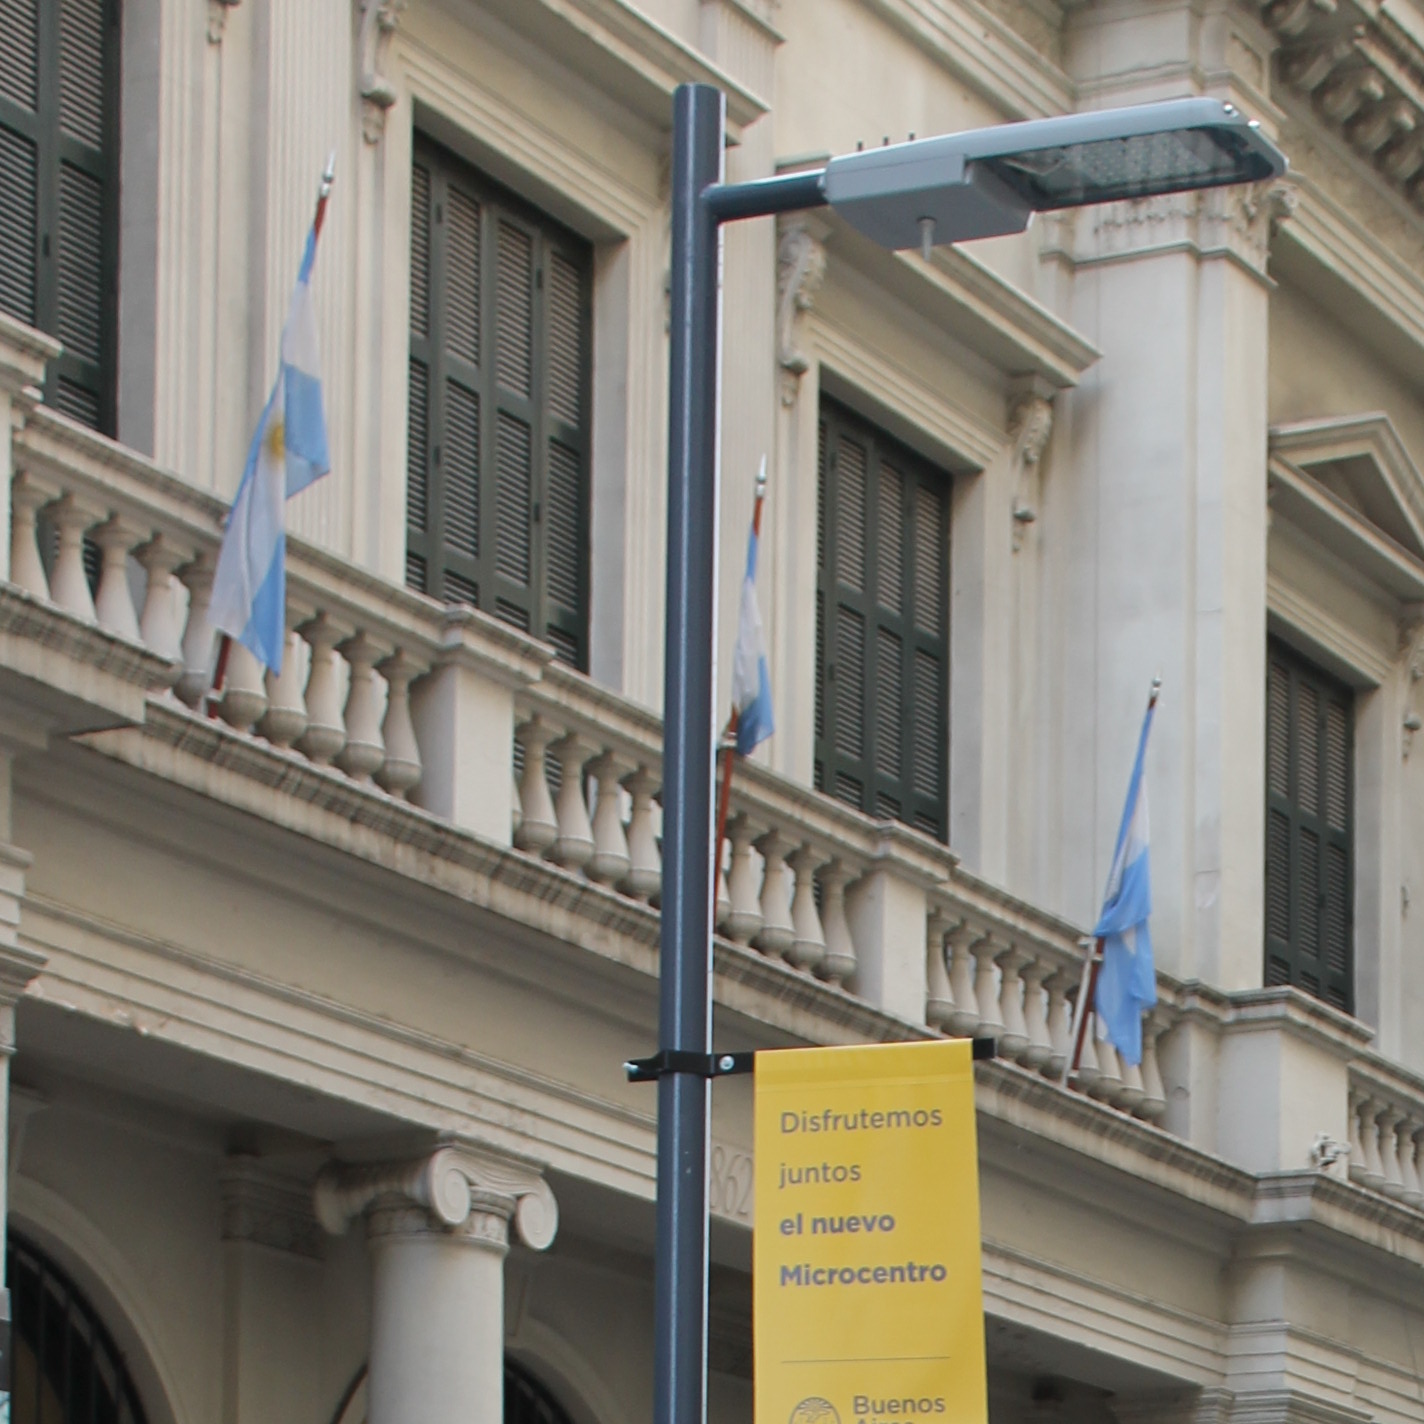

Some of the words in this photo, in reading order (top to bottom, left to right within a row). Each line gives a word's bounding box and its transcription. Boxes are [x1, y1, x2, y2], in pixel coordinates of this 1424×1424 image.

[781, 1109, 943, 1134] Disfrutemos
[779, 1163, 861, 1189] juntos
[780, 1213, 803, 1236] el
[811, 1214, 896, 1235] nuevo
[780, 1262, 948, 1287] Microcentro
[853, 1395, 946, 1415] Buenos
